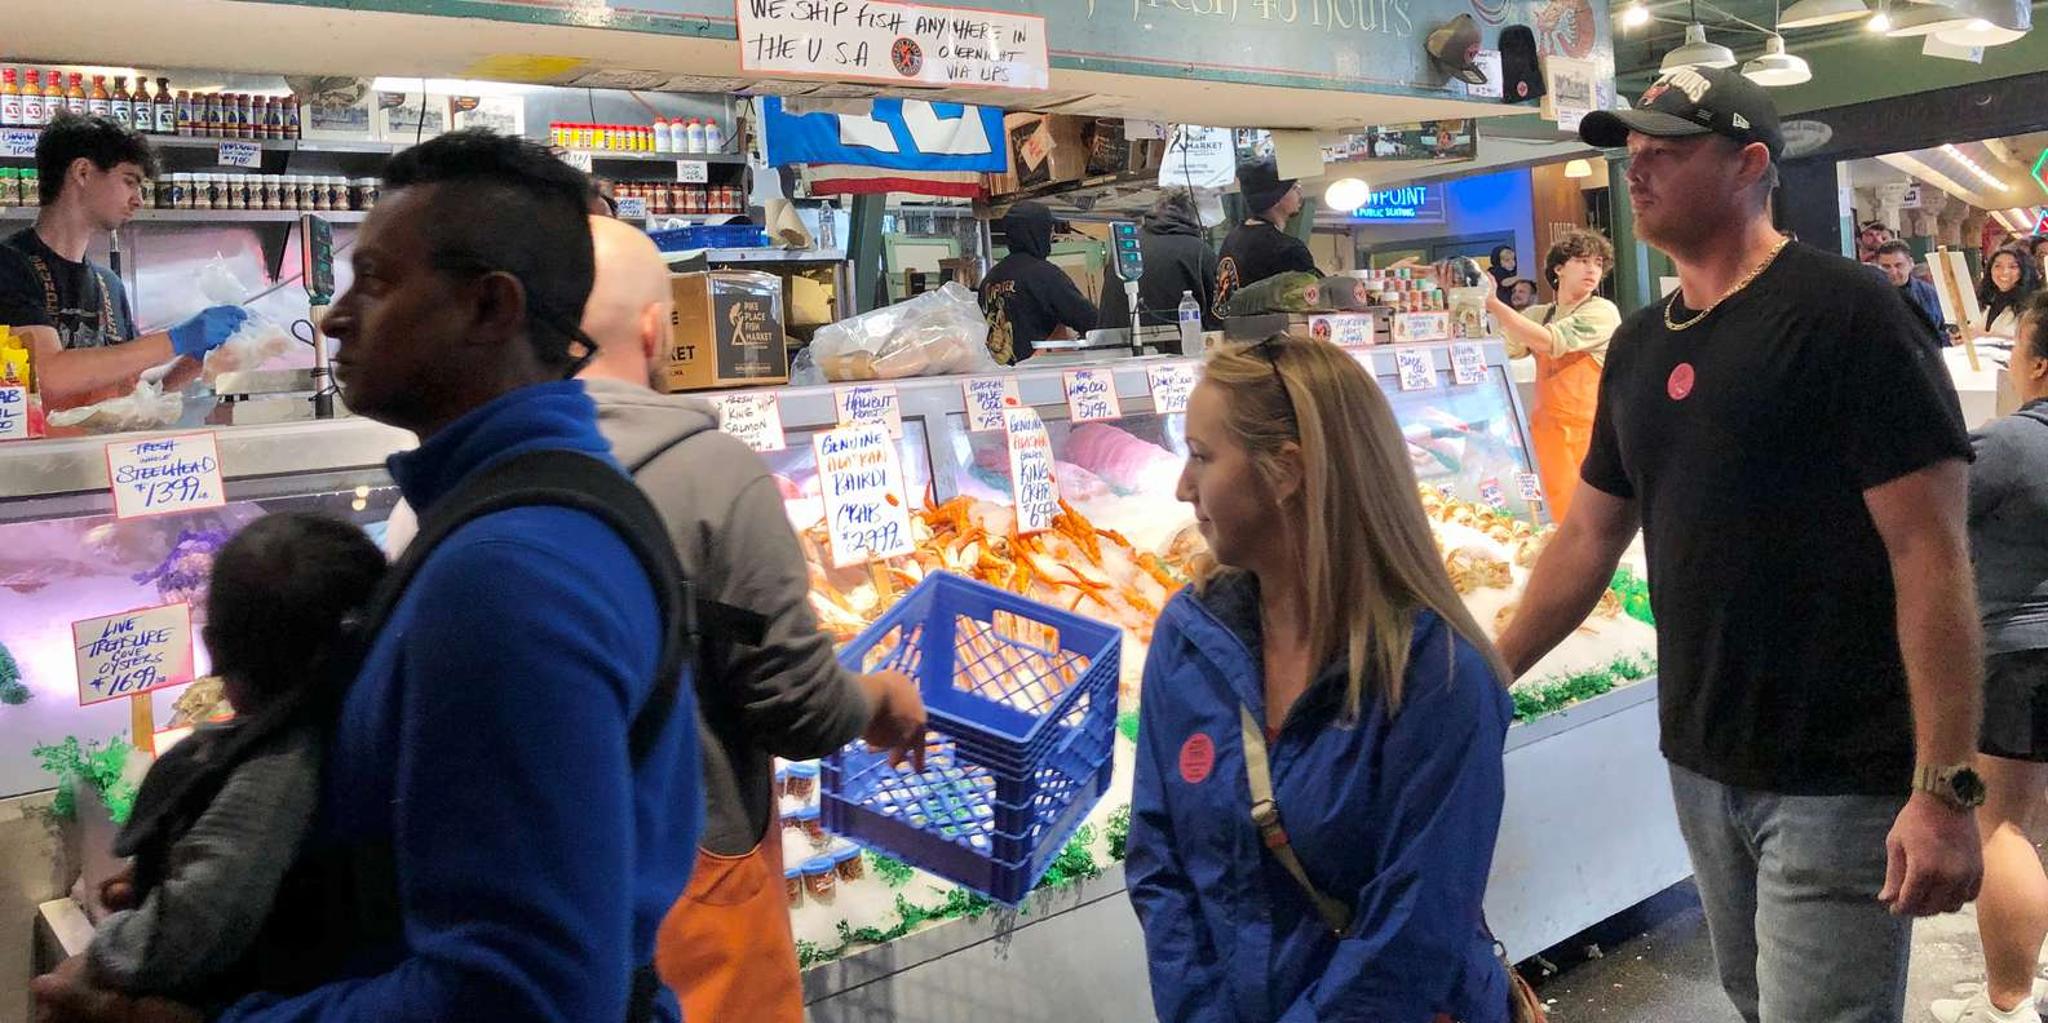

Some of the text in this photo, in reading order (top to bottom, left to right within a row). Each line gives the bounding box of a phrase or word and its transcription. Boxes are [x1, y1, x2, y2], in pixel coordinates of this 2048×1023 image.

[750, 0, 784, 19] WE
[1012, 24, 1027, 44] IN
[748, 32, 799, 61] THE
[946, 63, 1011, 82] VIA UPS
[744, 311, 767, 321] PLACE
[746, 331, 773, 343] MARKET
[724, 417, 768, 434] SALMON
[116, 456, 217, 484] STEELHEAD
[102, 616, 144, 639] LIVE
[98, 651, 165, 676] OYSTERS
[111, 646, 144, 662] COVE
